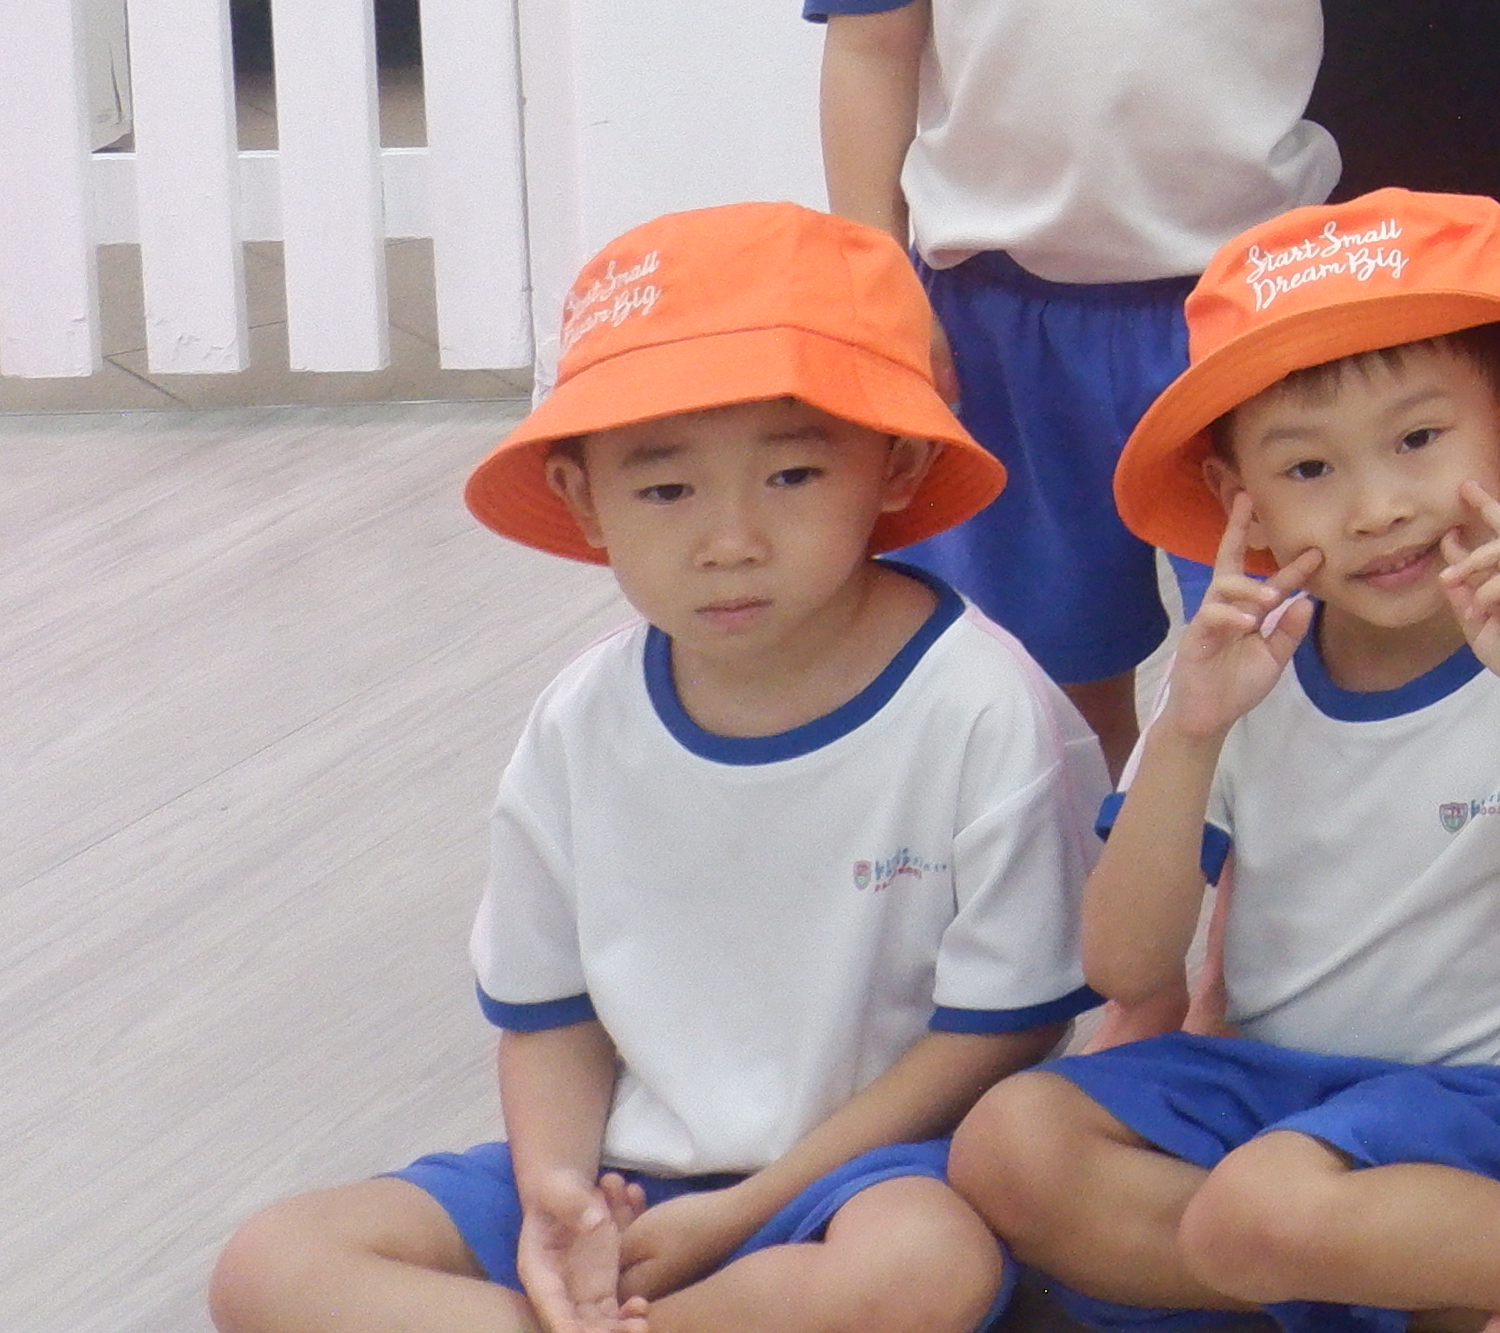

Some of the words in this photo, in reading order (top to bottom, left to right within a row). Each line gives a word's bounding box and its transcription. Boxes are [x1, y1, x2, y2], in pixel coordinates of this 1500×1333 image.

[1245, 232, 1331, 284] Start
[1324, 217, 1403, 261] Small
[1252, 260, 1345, 313] Dream
[1342, 246, 1410, 283] Big
